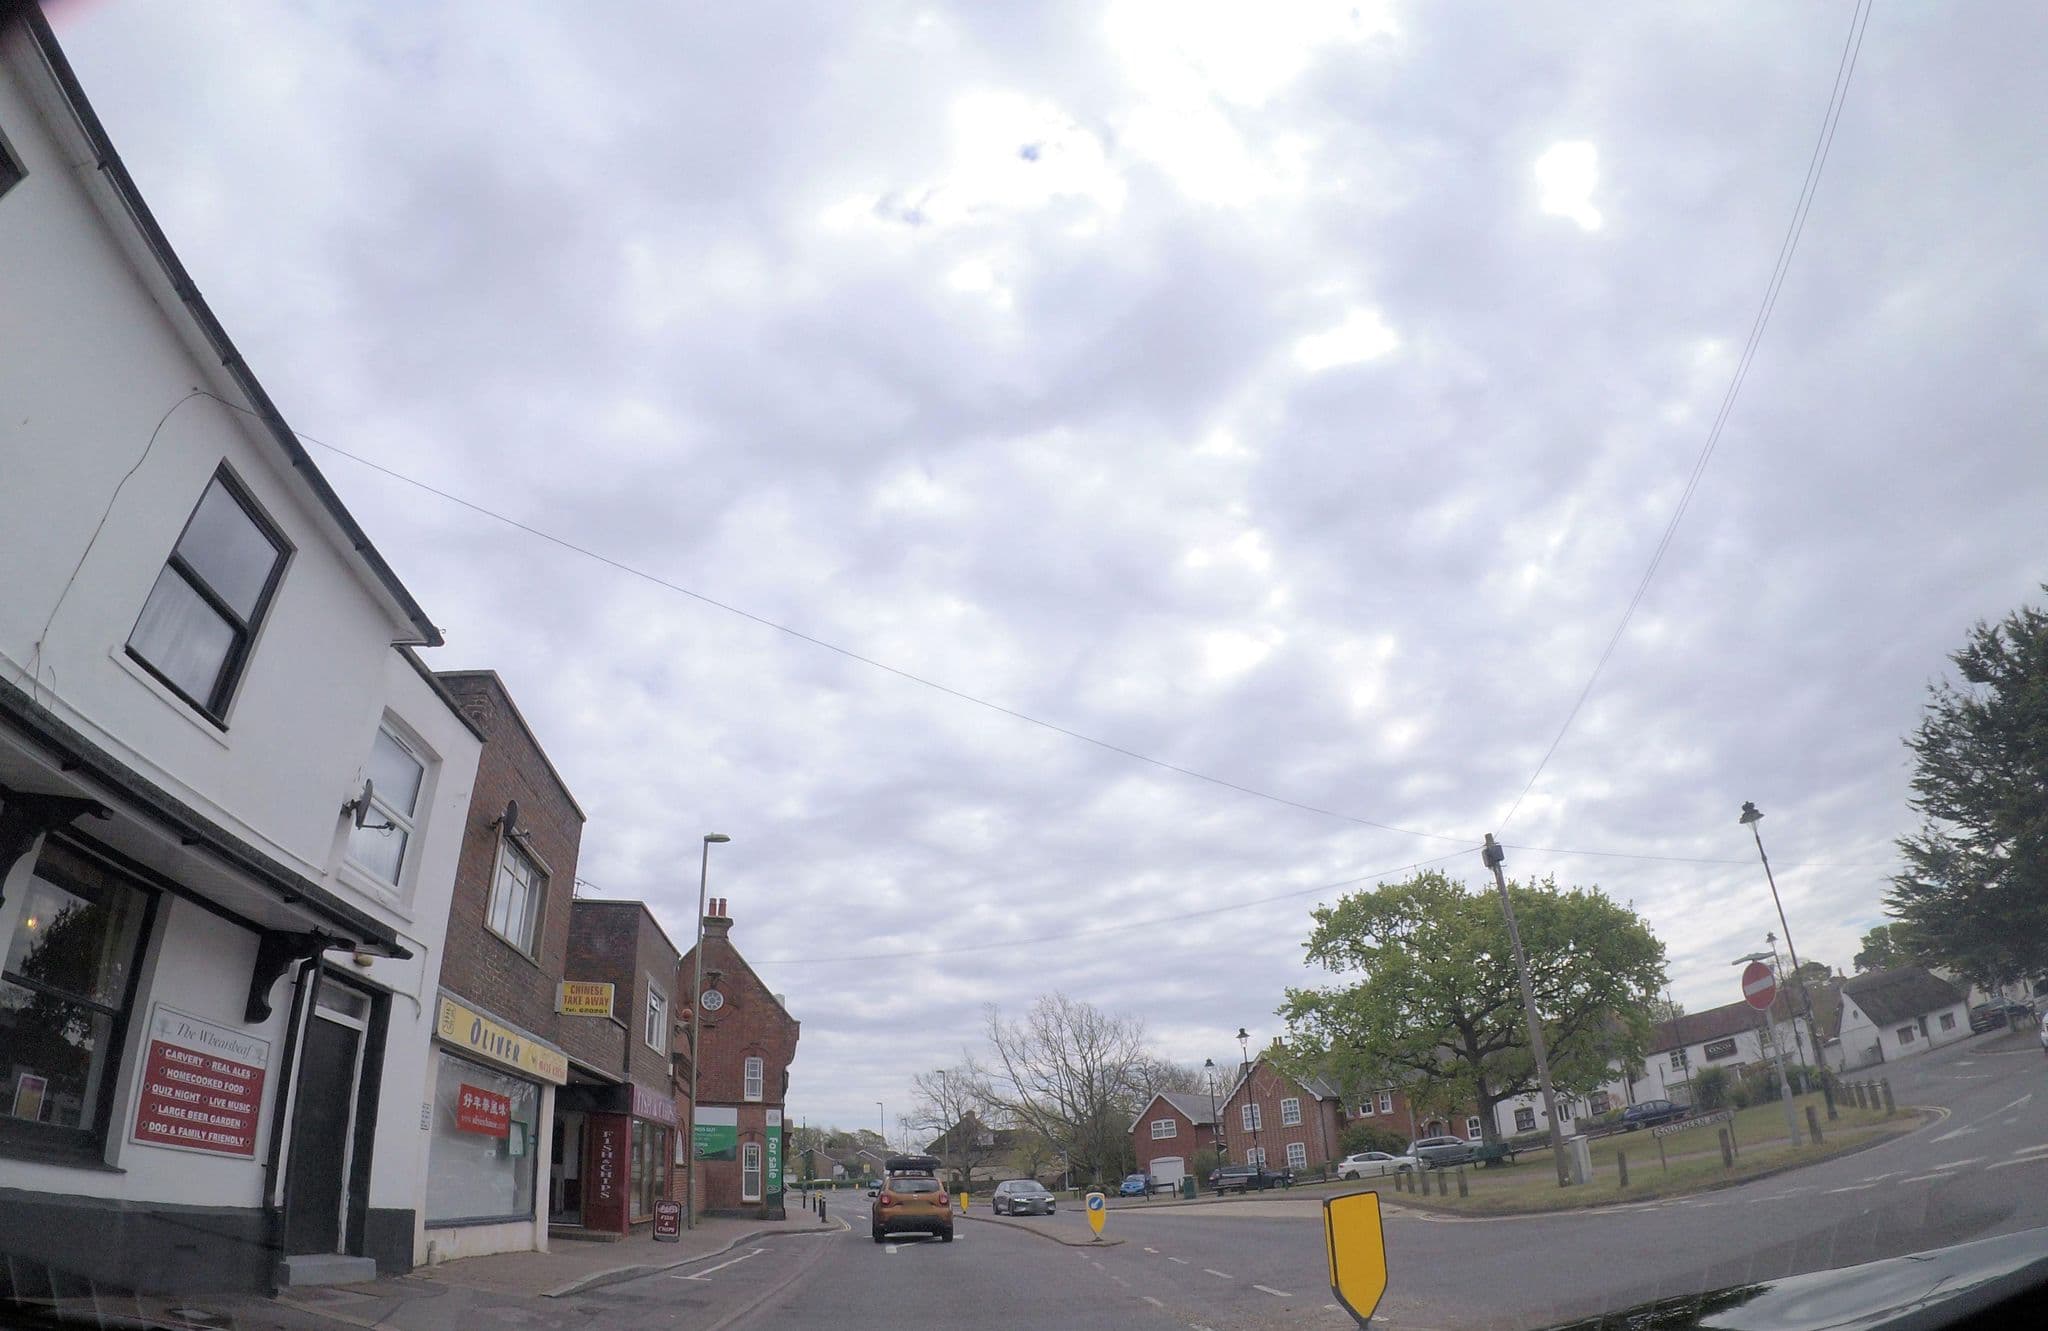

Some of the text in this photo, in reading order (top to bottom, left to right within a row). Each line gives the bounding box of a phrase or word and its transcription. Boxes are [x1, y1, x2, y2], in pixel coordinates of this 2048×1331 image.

[563, 995, 609, 1007] TAKE AWAY
[570, 984, 604, 996] CHINESE
[177, 1022, 195, 1040] The
[165, 1048, 251, 1079] CARVERY REAL ALES
[167, 1067, 245, 1095] HOMECOOKED FOOD
[152, 1083, 251, 1113] QUIZ NIGHT LIVE MUSIC
[158, 1104, 241, 1128] LARGE BEER GARDEN
[148, 1121, 245, 1147] DOG & FAMILY FRIENDLY
[768, 1137, 779, 1179] For sale
